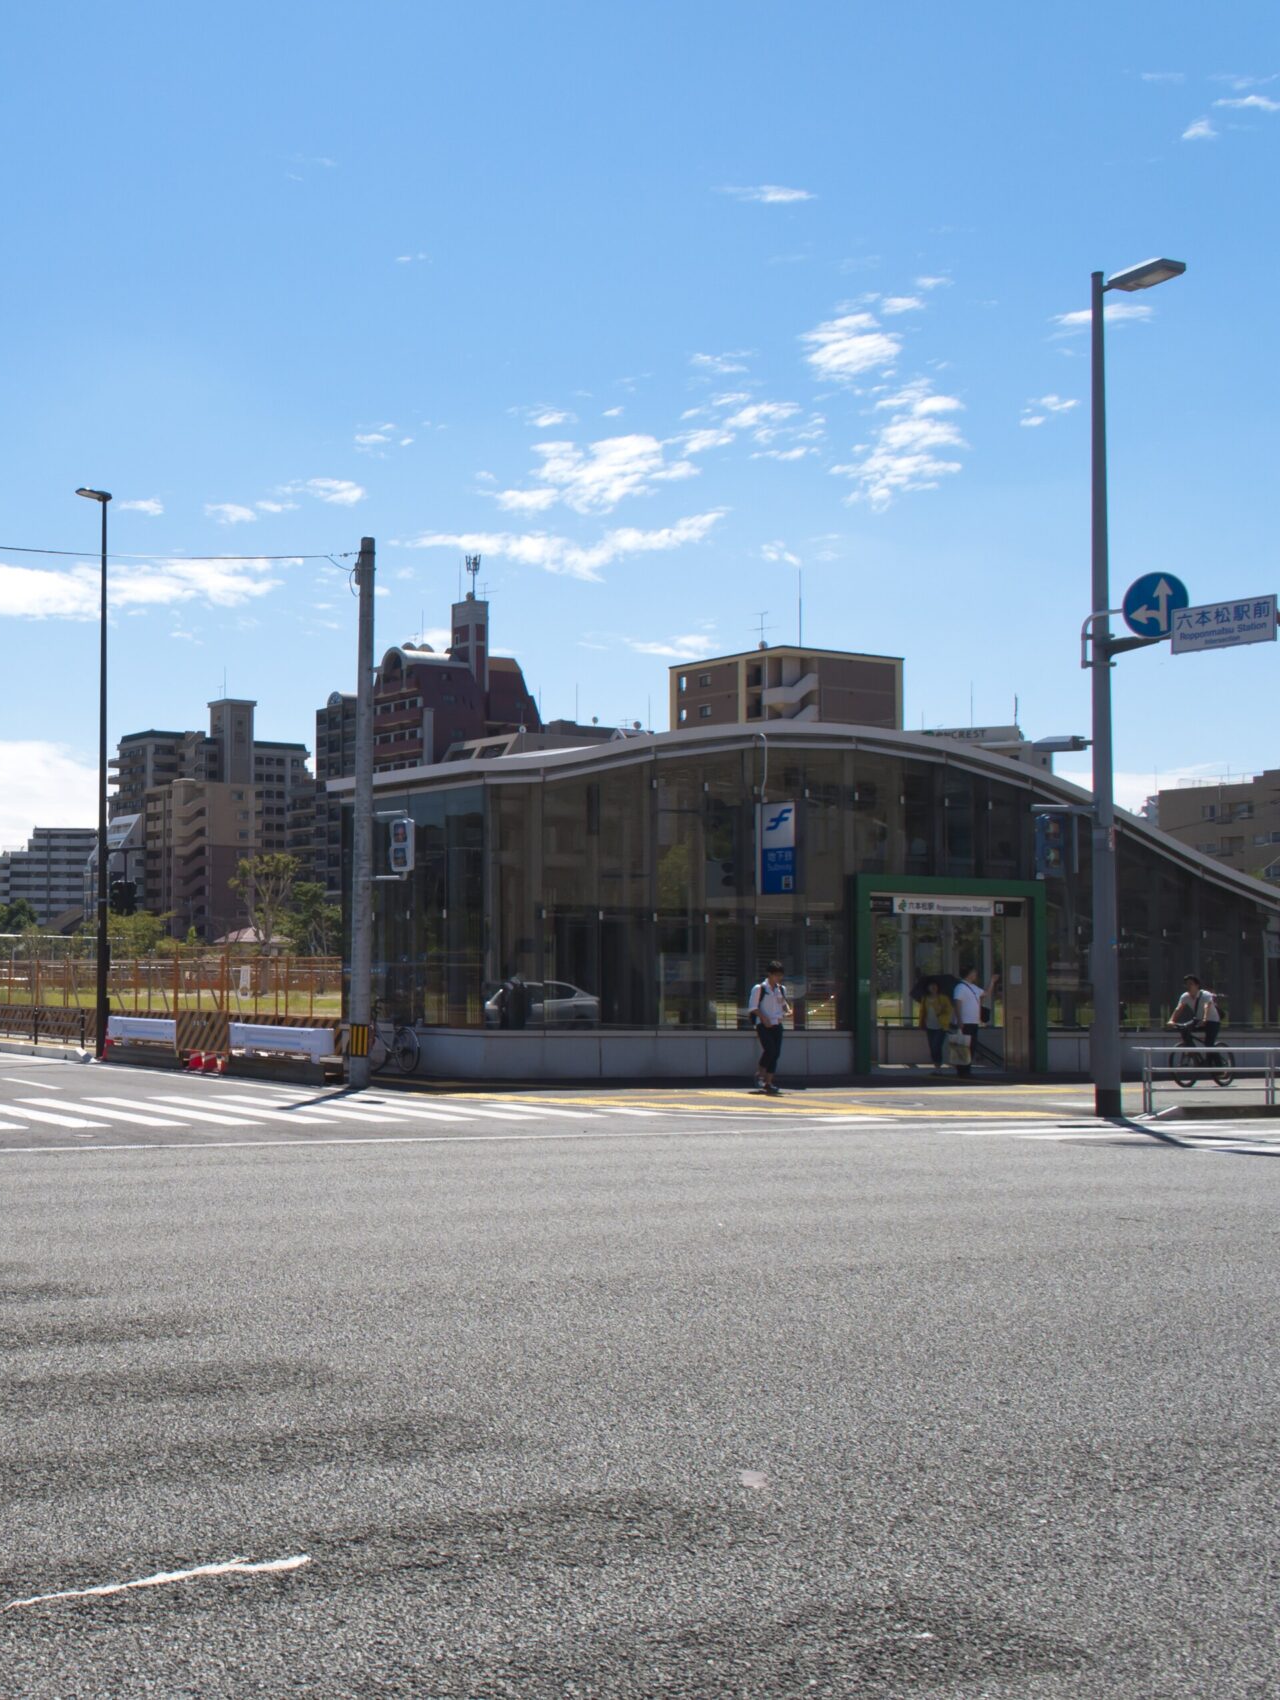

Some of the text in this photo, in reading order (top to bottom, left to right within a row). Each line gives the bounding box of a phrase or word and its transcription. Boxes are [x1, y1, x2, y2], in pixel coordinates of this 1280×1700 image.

[1176, 601, 1270, 630] 六本松駅前
[1237, 622, 1267, 633] Station
